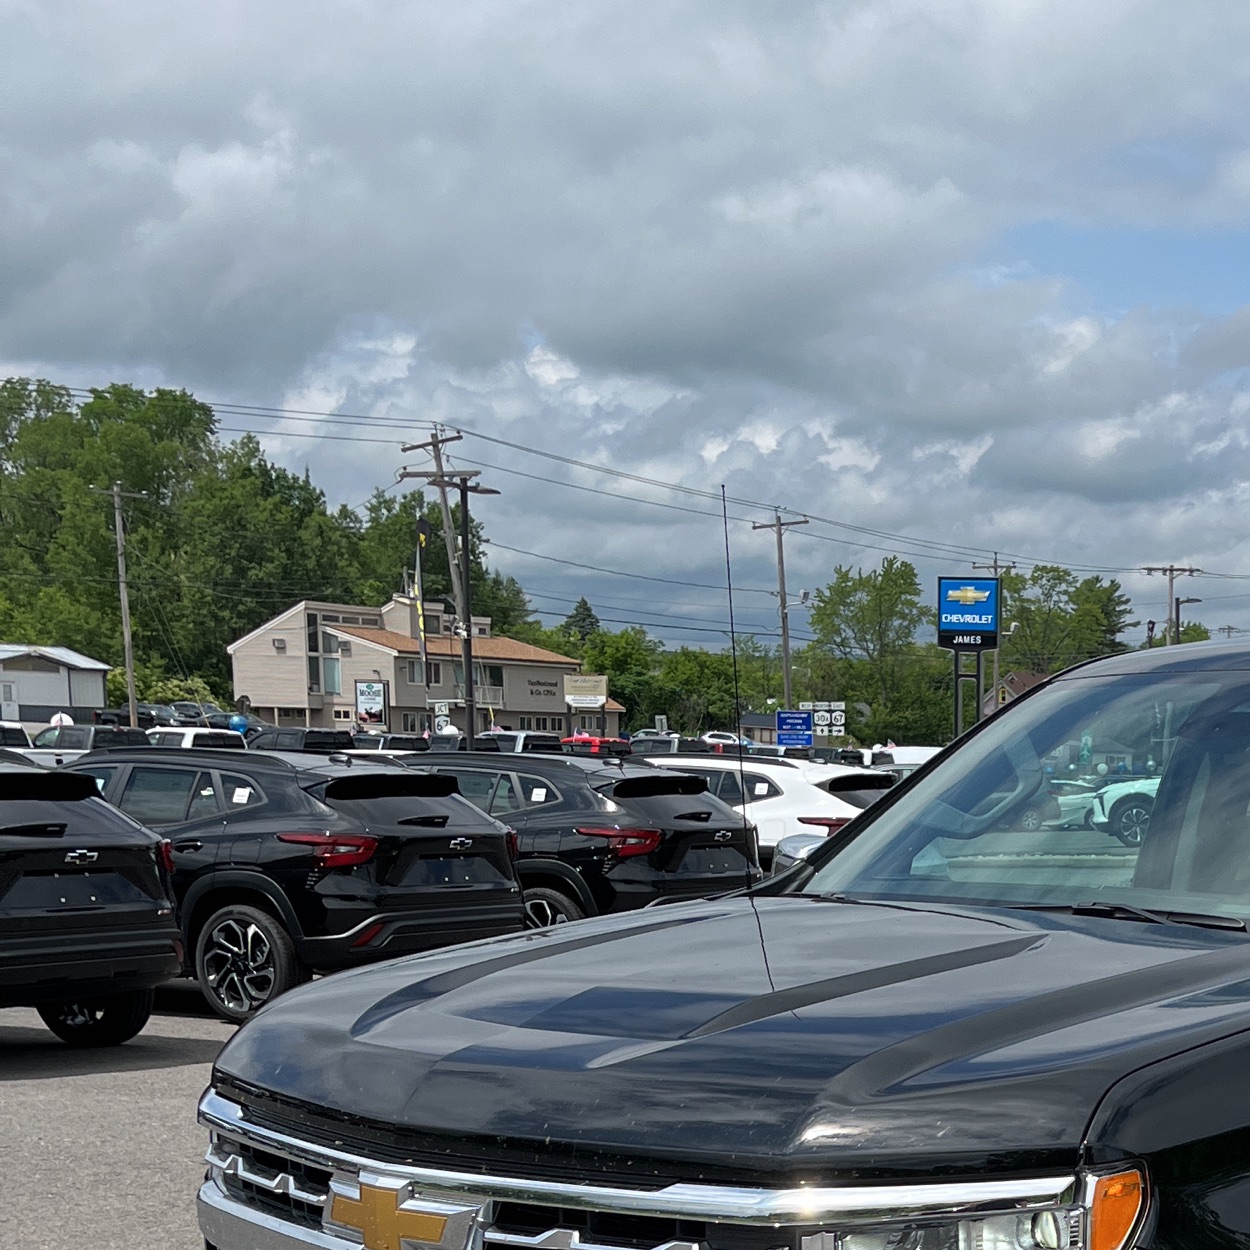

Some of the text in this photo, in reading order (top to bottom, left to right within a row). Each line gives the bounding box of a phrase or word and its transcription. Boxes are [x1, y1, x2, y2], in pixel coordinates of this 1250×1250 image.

[942, 614, 993, 624] CHEVROLET
[953, 635, 981, 644] JAMES
[359, 689, 382, 697] MOOSE
[437, 704, 447, 713] JCT
[815, 714, 829, 722] 30A
[833, 714, 843, 723] 67
[436, 719, 449, 731] 67
